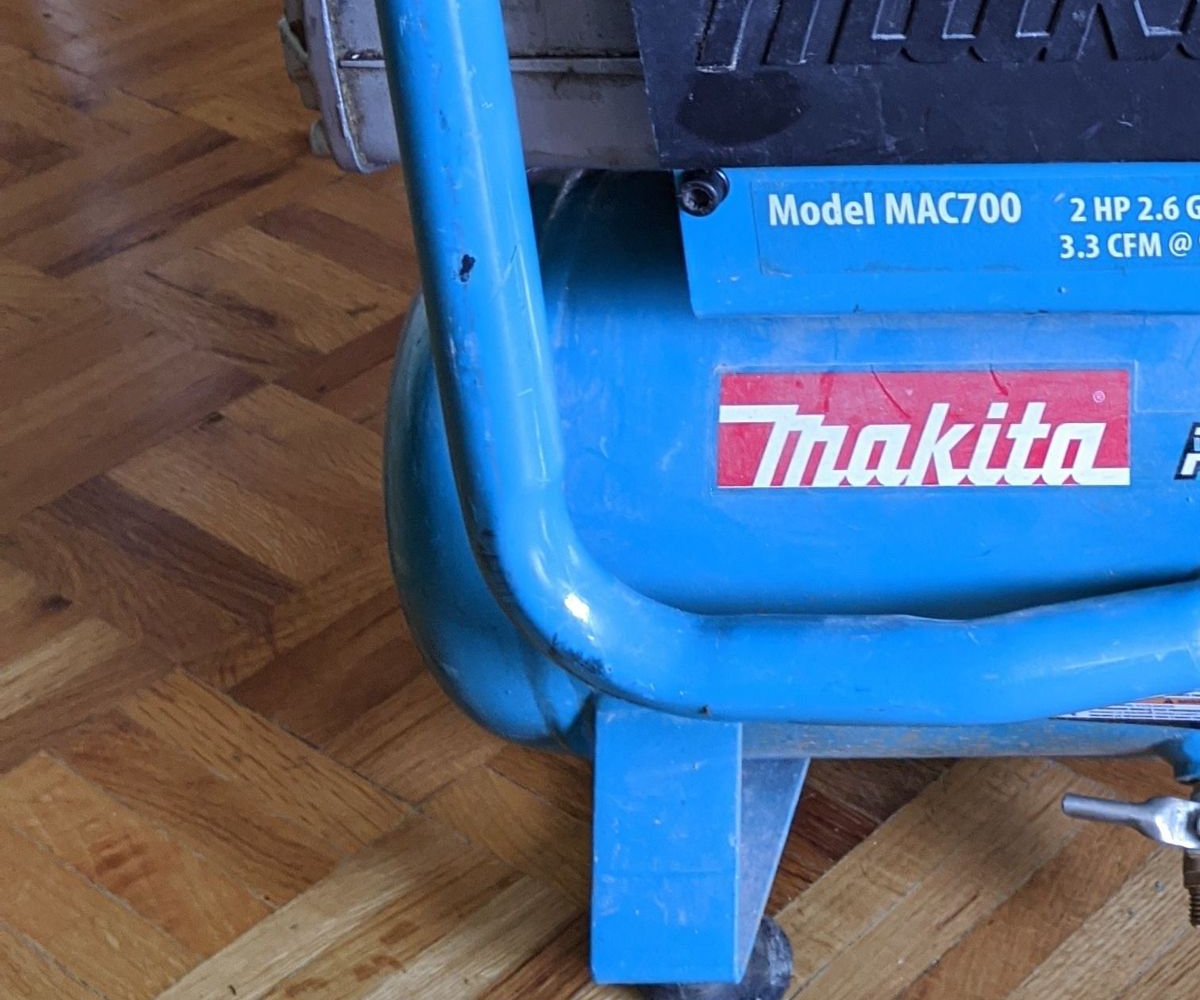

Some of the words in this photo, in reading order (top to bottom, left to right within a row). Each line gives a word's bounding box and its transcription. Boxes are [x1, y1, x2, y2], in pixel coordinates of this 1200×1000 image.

[768, 192, 876, 226] Model
[884, 191, 1022, 226] MAC700
[1070, 196, 1087, 221] 2
[1095, 196, 1129, 221] HP
[1137, 195, 1180, 221] 2.6
[1059, 234, 1100, 260] 3.3
[1106, 233, 1163, 259] CFM
[1168, 233, 1193, 258] @
